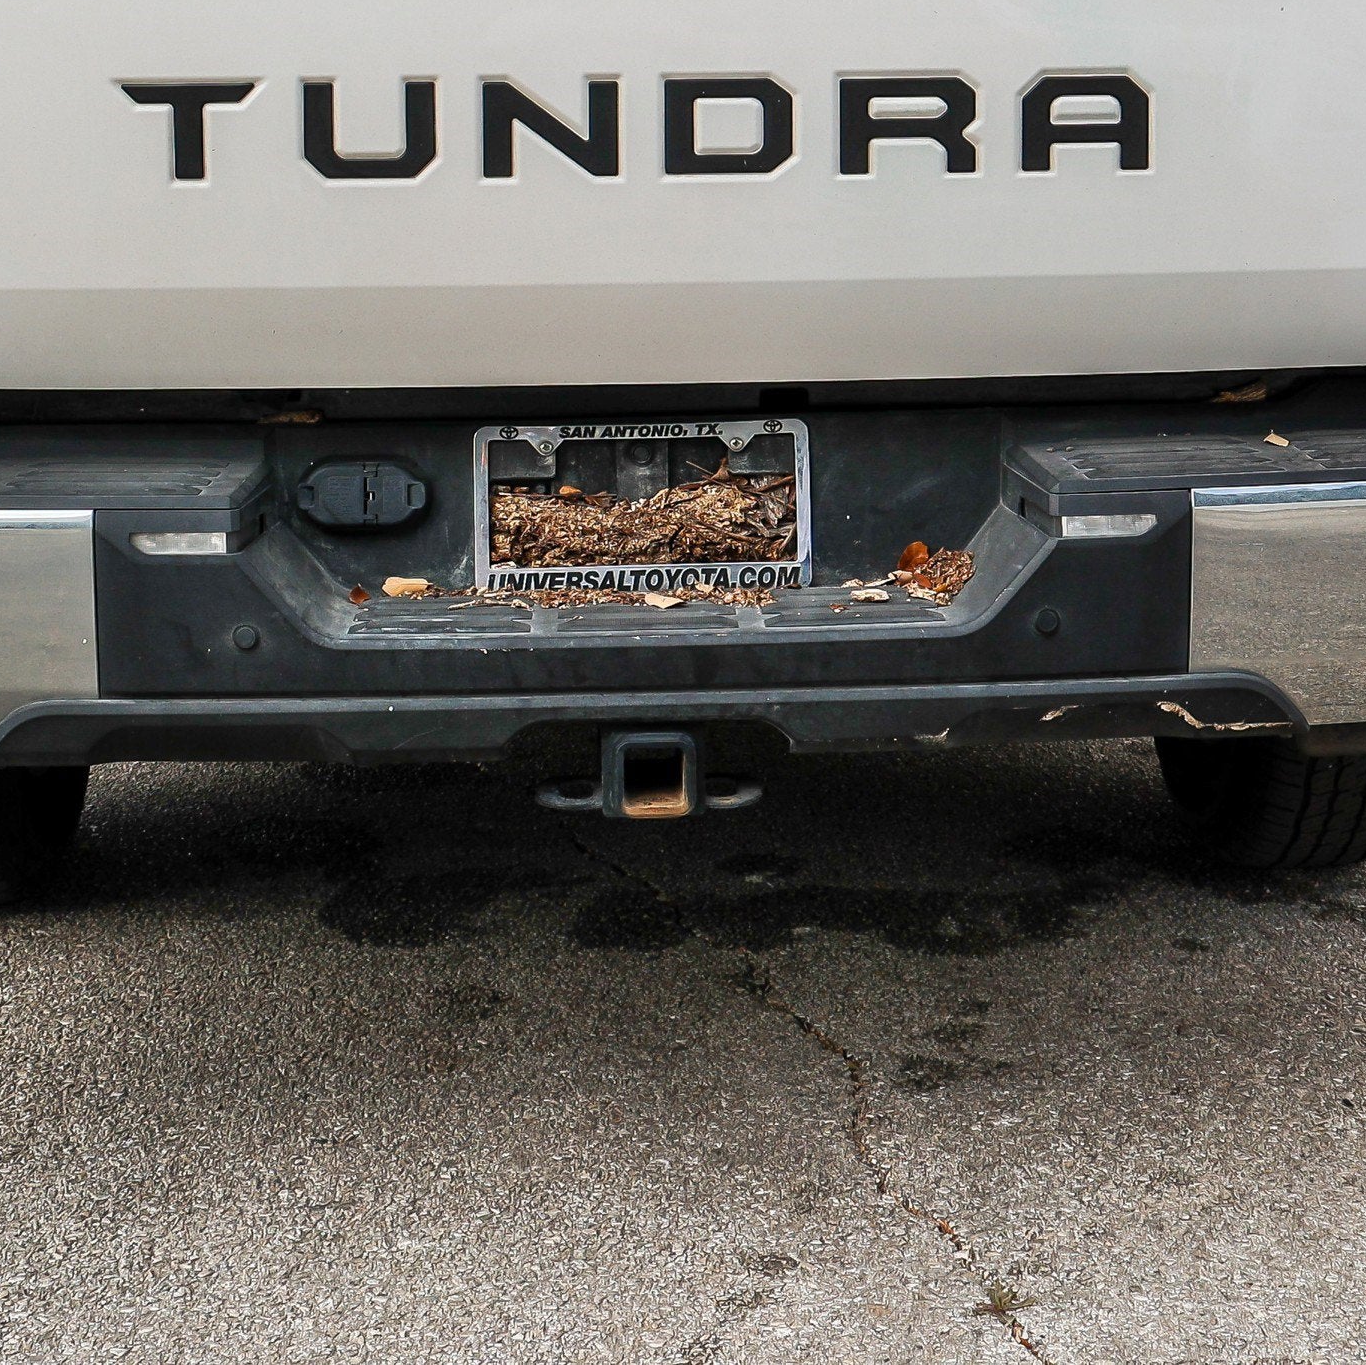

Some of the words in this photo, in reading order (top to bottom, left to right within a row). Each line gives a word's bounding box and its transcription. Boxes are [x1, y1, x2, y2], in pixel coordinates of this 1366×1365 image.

[120, 75, 1151, 181] TUNDRA
[559, 426, 596, 438] SAN
[600, 423, 688, 439] ANTONIO,
[695, 423, 724, 435] TX.
[489, 566, 802, 592] UNIVERSALTOYOTA.COM
